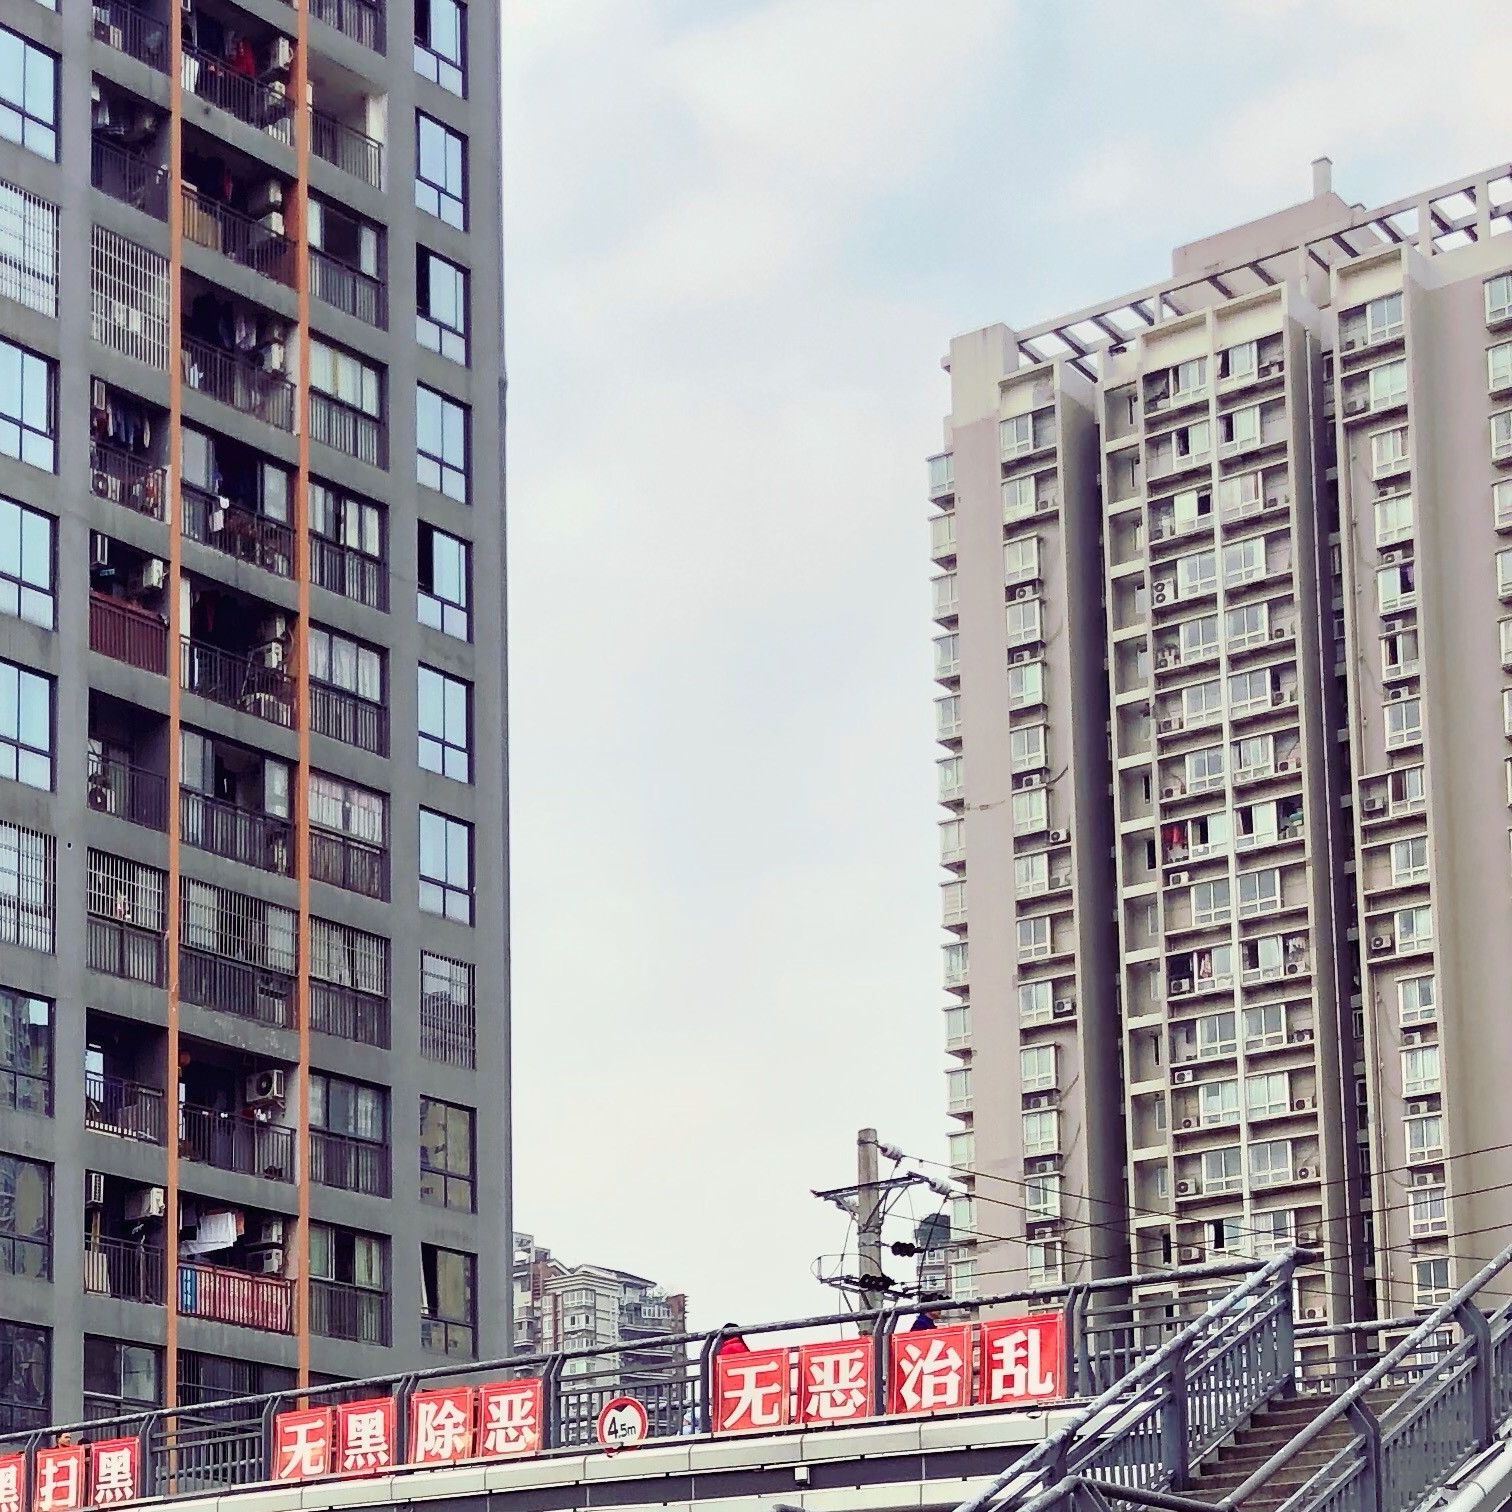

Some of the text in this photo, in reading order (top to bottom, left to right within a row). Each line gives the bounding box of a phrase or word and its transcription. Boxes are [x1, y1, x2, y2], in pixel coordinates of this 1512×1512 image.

[722, 1330, 1054, 1431] 无恶治乱
[277, 1389, 537, 1478] 无黑除恶
[607, 1416, 636, 1439] 4.5m
